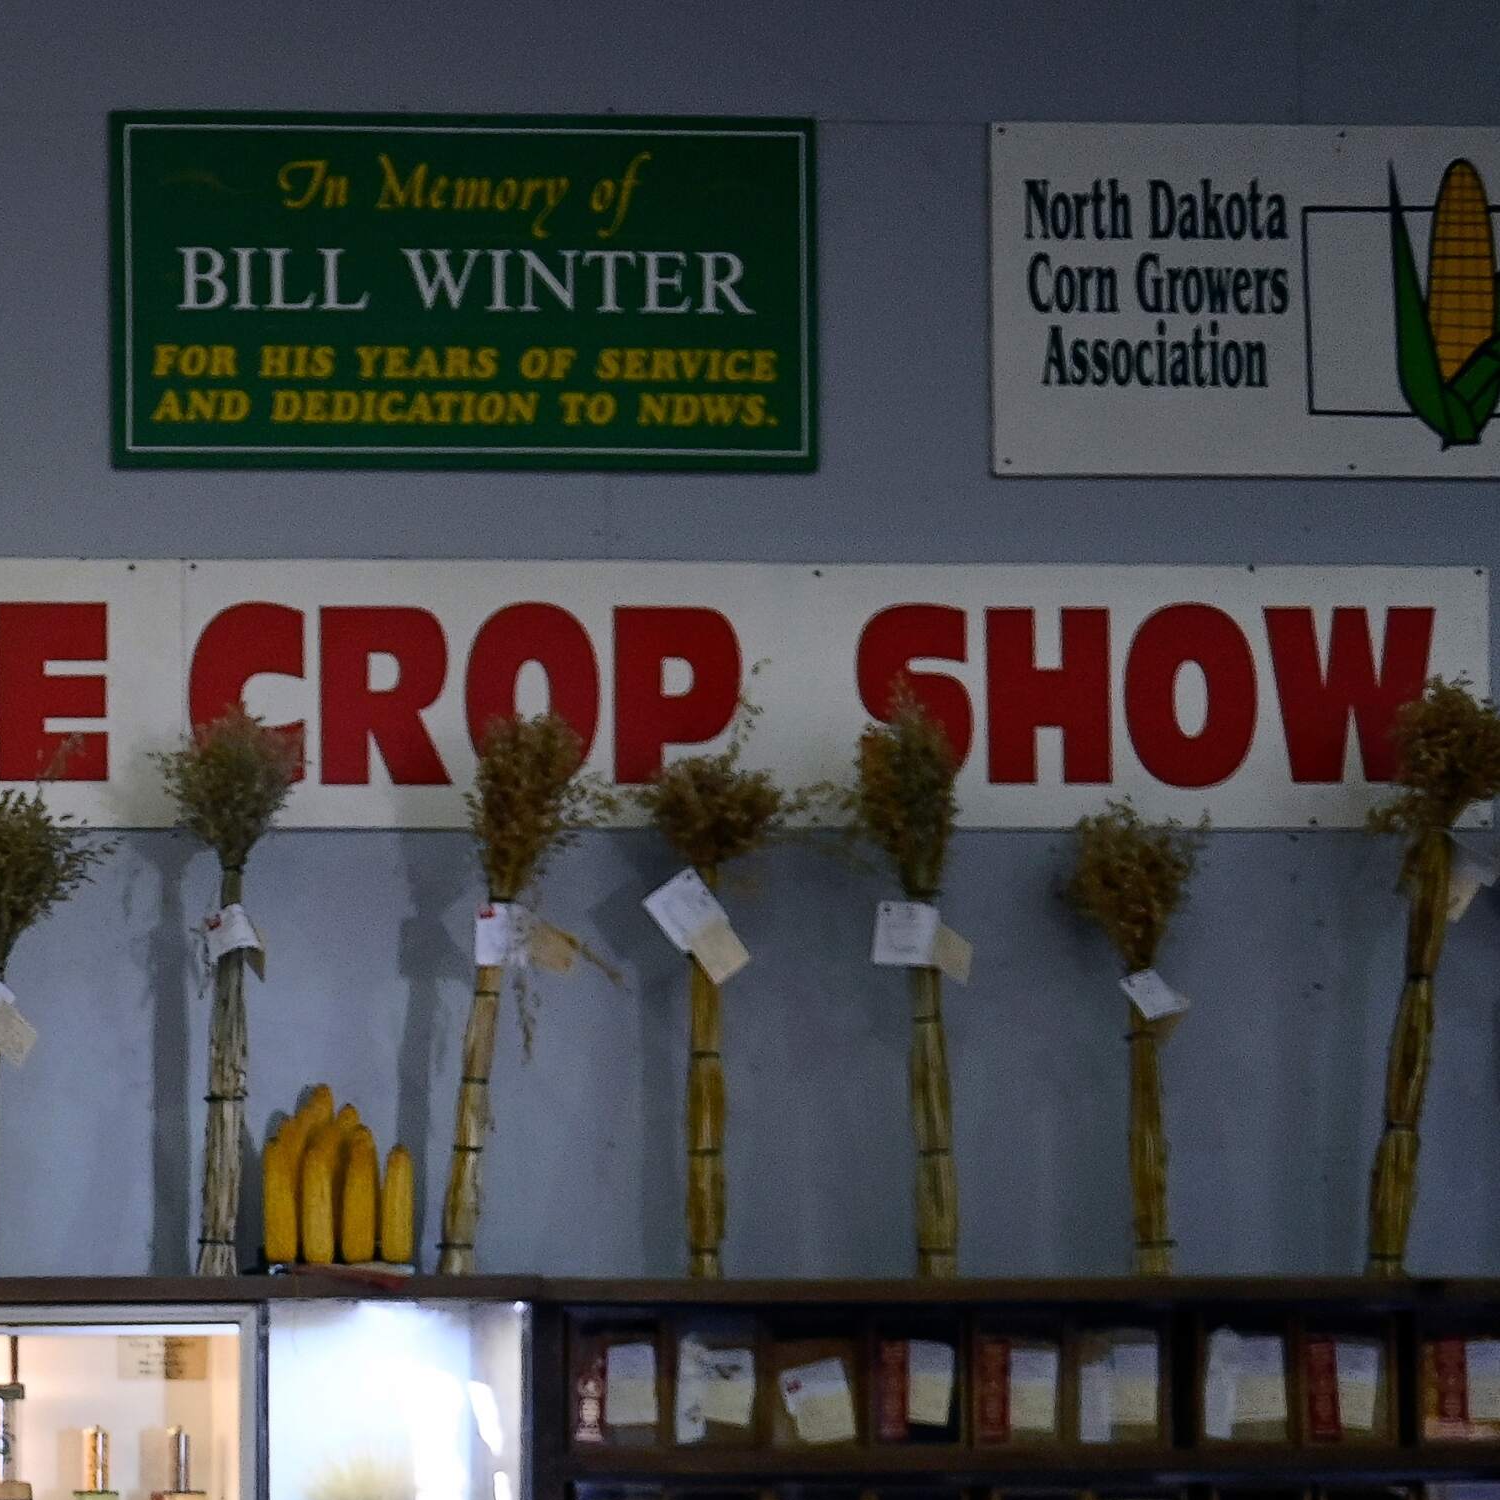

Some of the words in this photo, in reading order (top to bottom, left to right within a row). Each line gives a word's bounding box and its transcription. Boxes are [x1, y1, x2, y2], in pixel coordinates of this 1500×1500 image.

[276, 159, 349, 210] In
[374, 152, 572, 239] Memory
[588, 150, 654, 239] of
[1023, 178, 1133, 241] North
[1148, 178, 1289, 241] Dakota
[175, 246, 371, 312] BILL
[400, 248, 757, 315] WINTER
[1027, 252, 1120, 314] Corn
[1135, 252, 1290, 315] Growers
[152, 343, 239, 378] FOR
[258, 345, 338, 380] HIS
[355, 345, 499, 381] YEARS
[517, 346, 579, 381] OF
[595, 348, 778, 383] SERVICE
[1041, 320, 1269, 388] Association
[151, 389, 252, 423] AND
[270, 389, 540, 426] DEDICATION
[559, 392, 619, 426] TO
[636, 392, 779, 428] NDWS.
[188, 601, 744, 786] CROP
[856, 602, 1436, 788] SHOW
